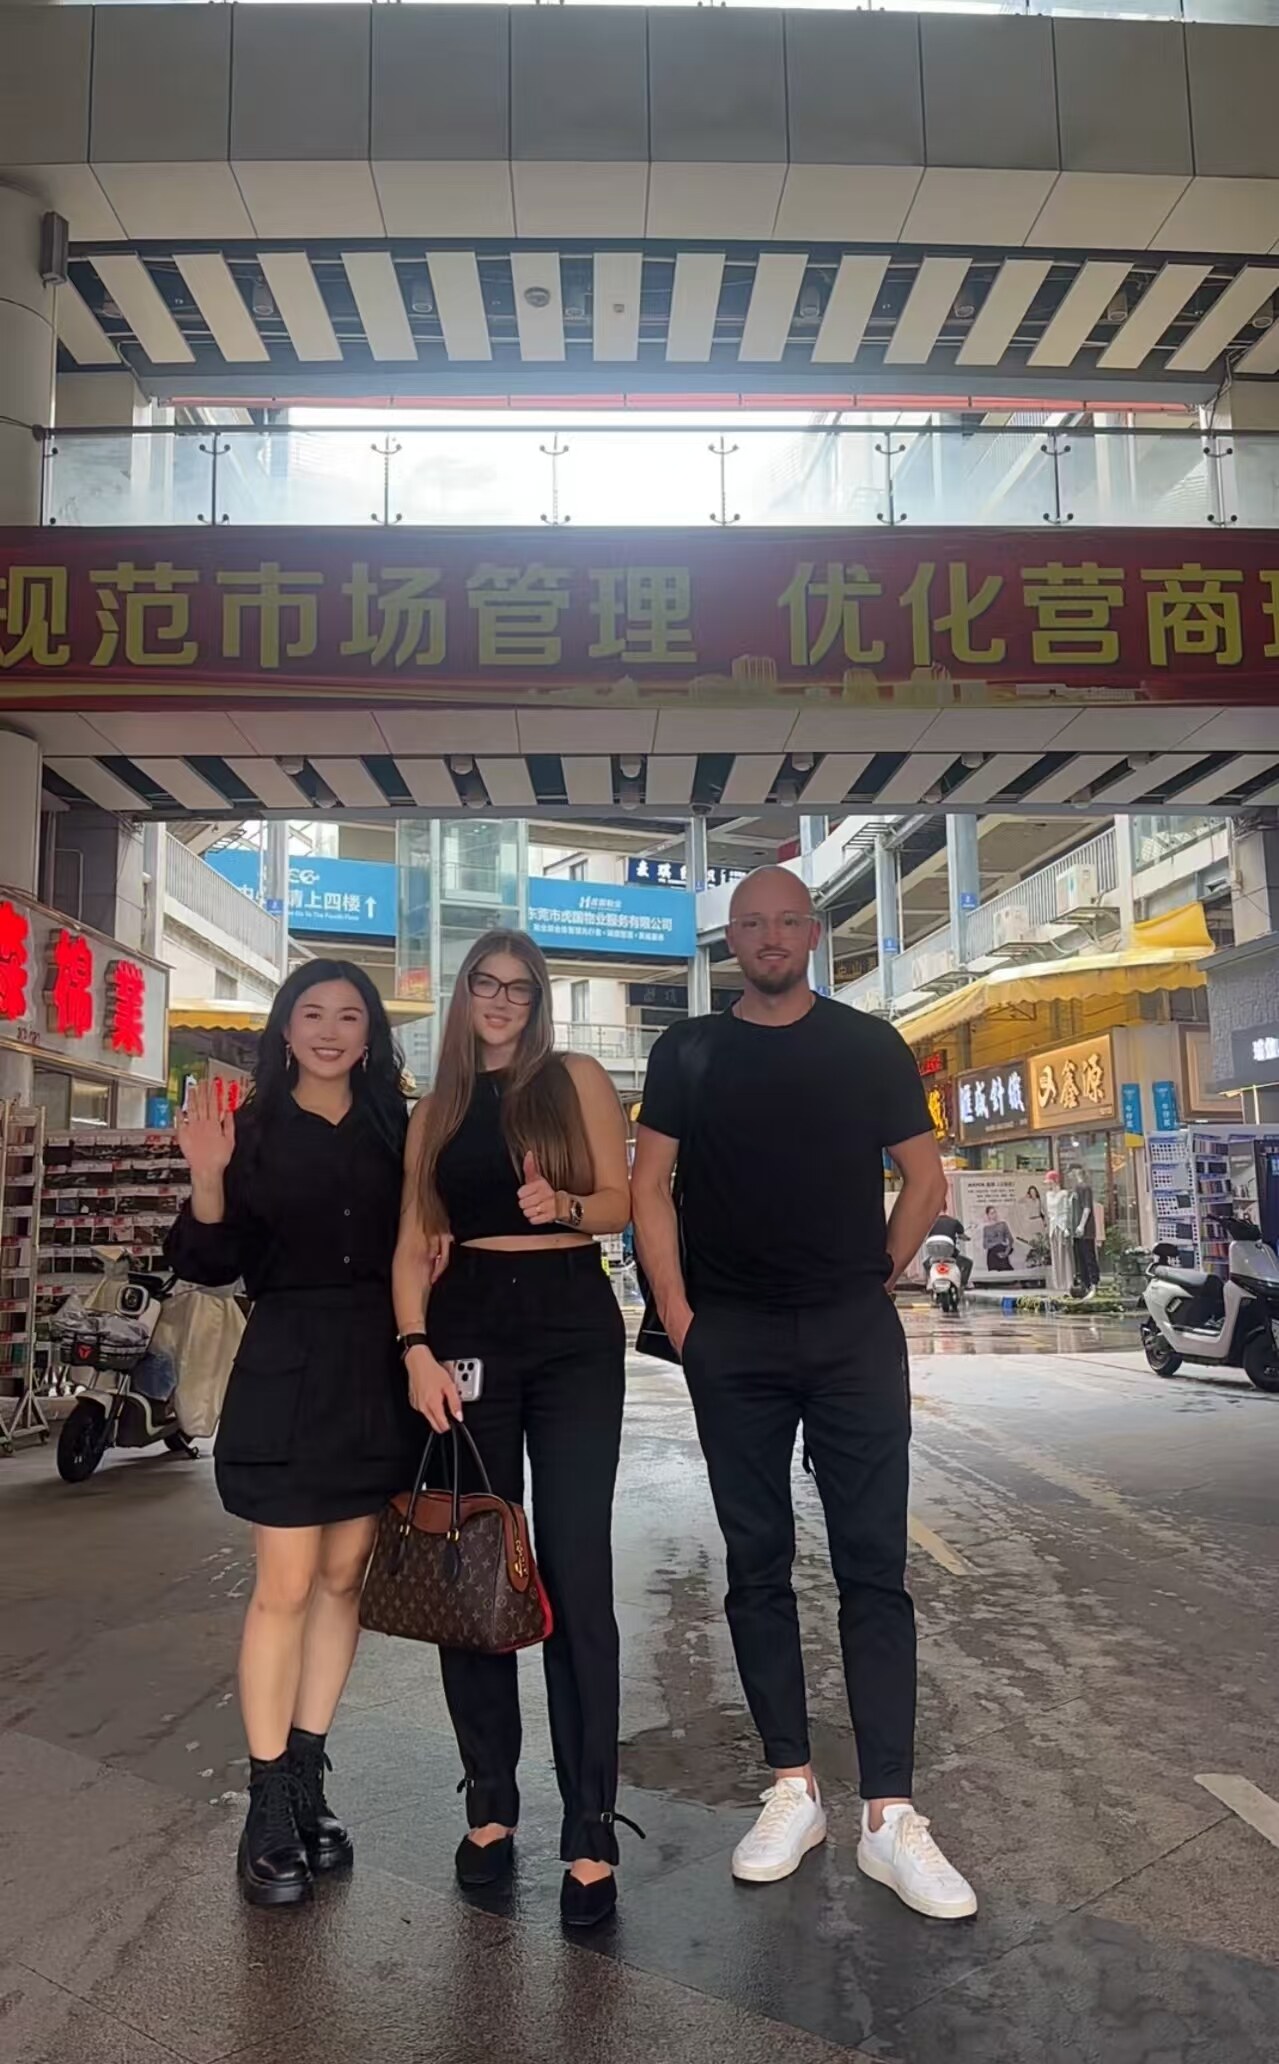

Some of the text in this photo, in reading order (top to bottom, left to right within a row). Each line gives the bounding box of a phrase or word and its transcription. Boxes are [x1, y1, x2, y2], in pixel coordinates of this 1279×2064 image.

[0, 561, 1279, 668] 规范市场管理 优化营商
